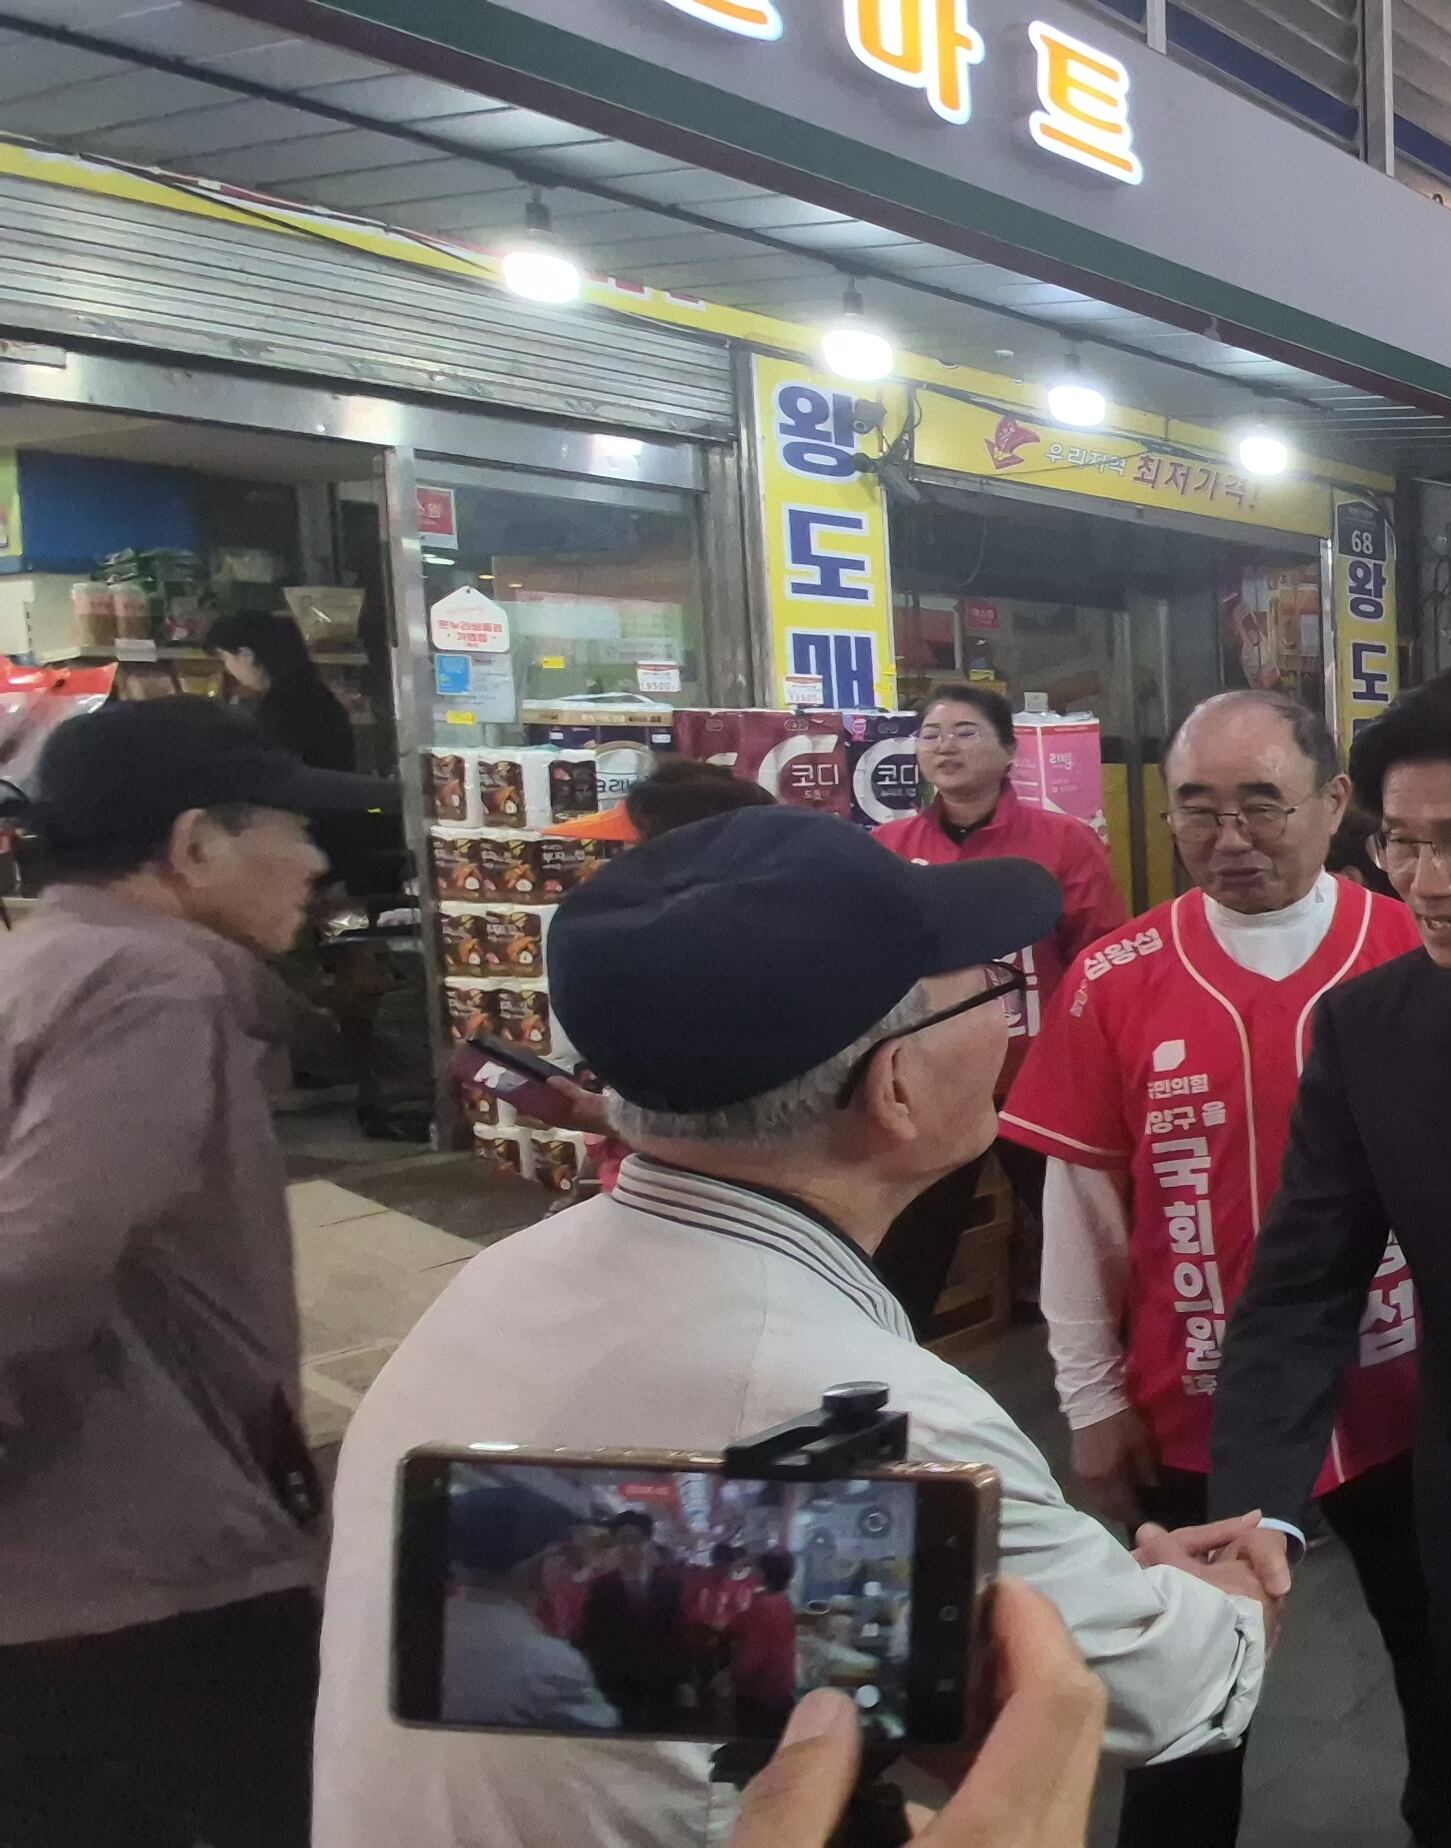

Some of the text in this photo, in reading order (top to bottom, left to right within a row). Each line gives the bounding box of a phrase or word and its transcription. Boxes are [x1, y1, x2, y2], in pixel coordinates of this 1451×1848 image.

[655, 0, 1144, 186] 마트
[1351, 530, 1374, 555] 68
[792, 764, 839, 787] 코디
[877, 764, 919, 786] 코디
